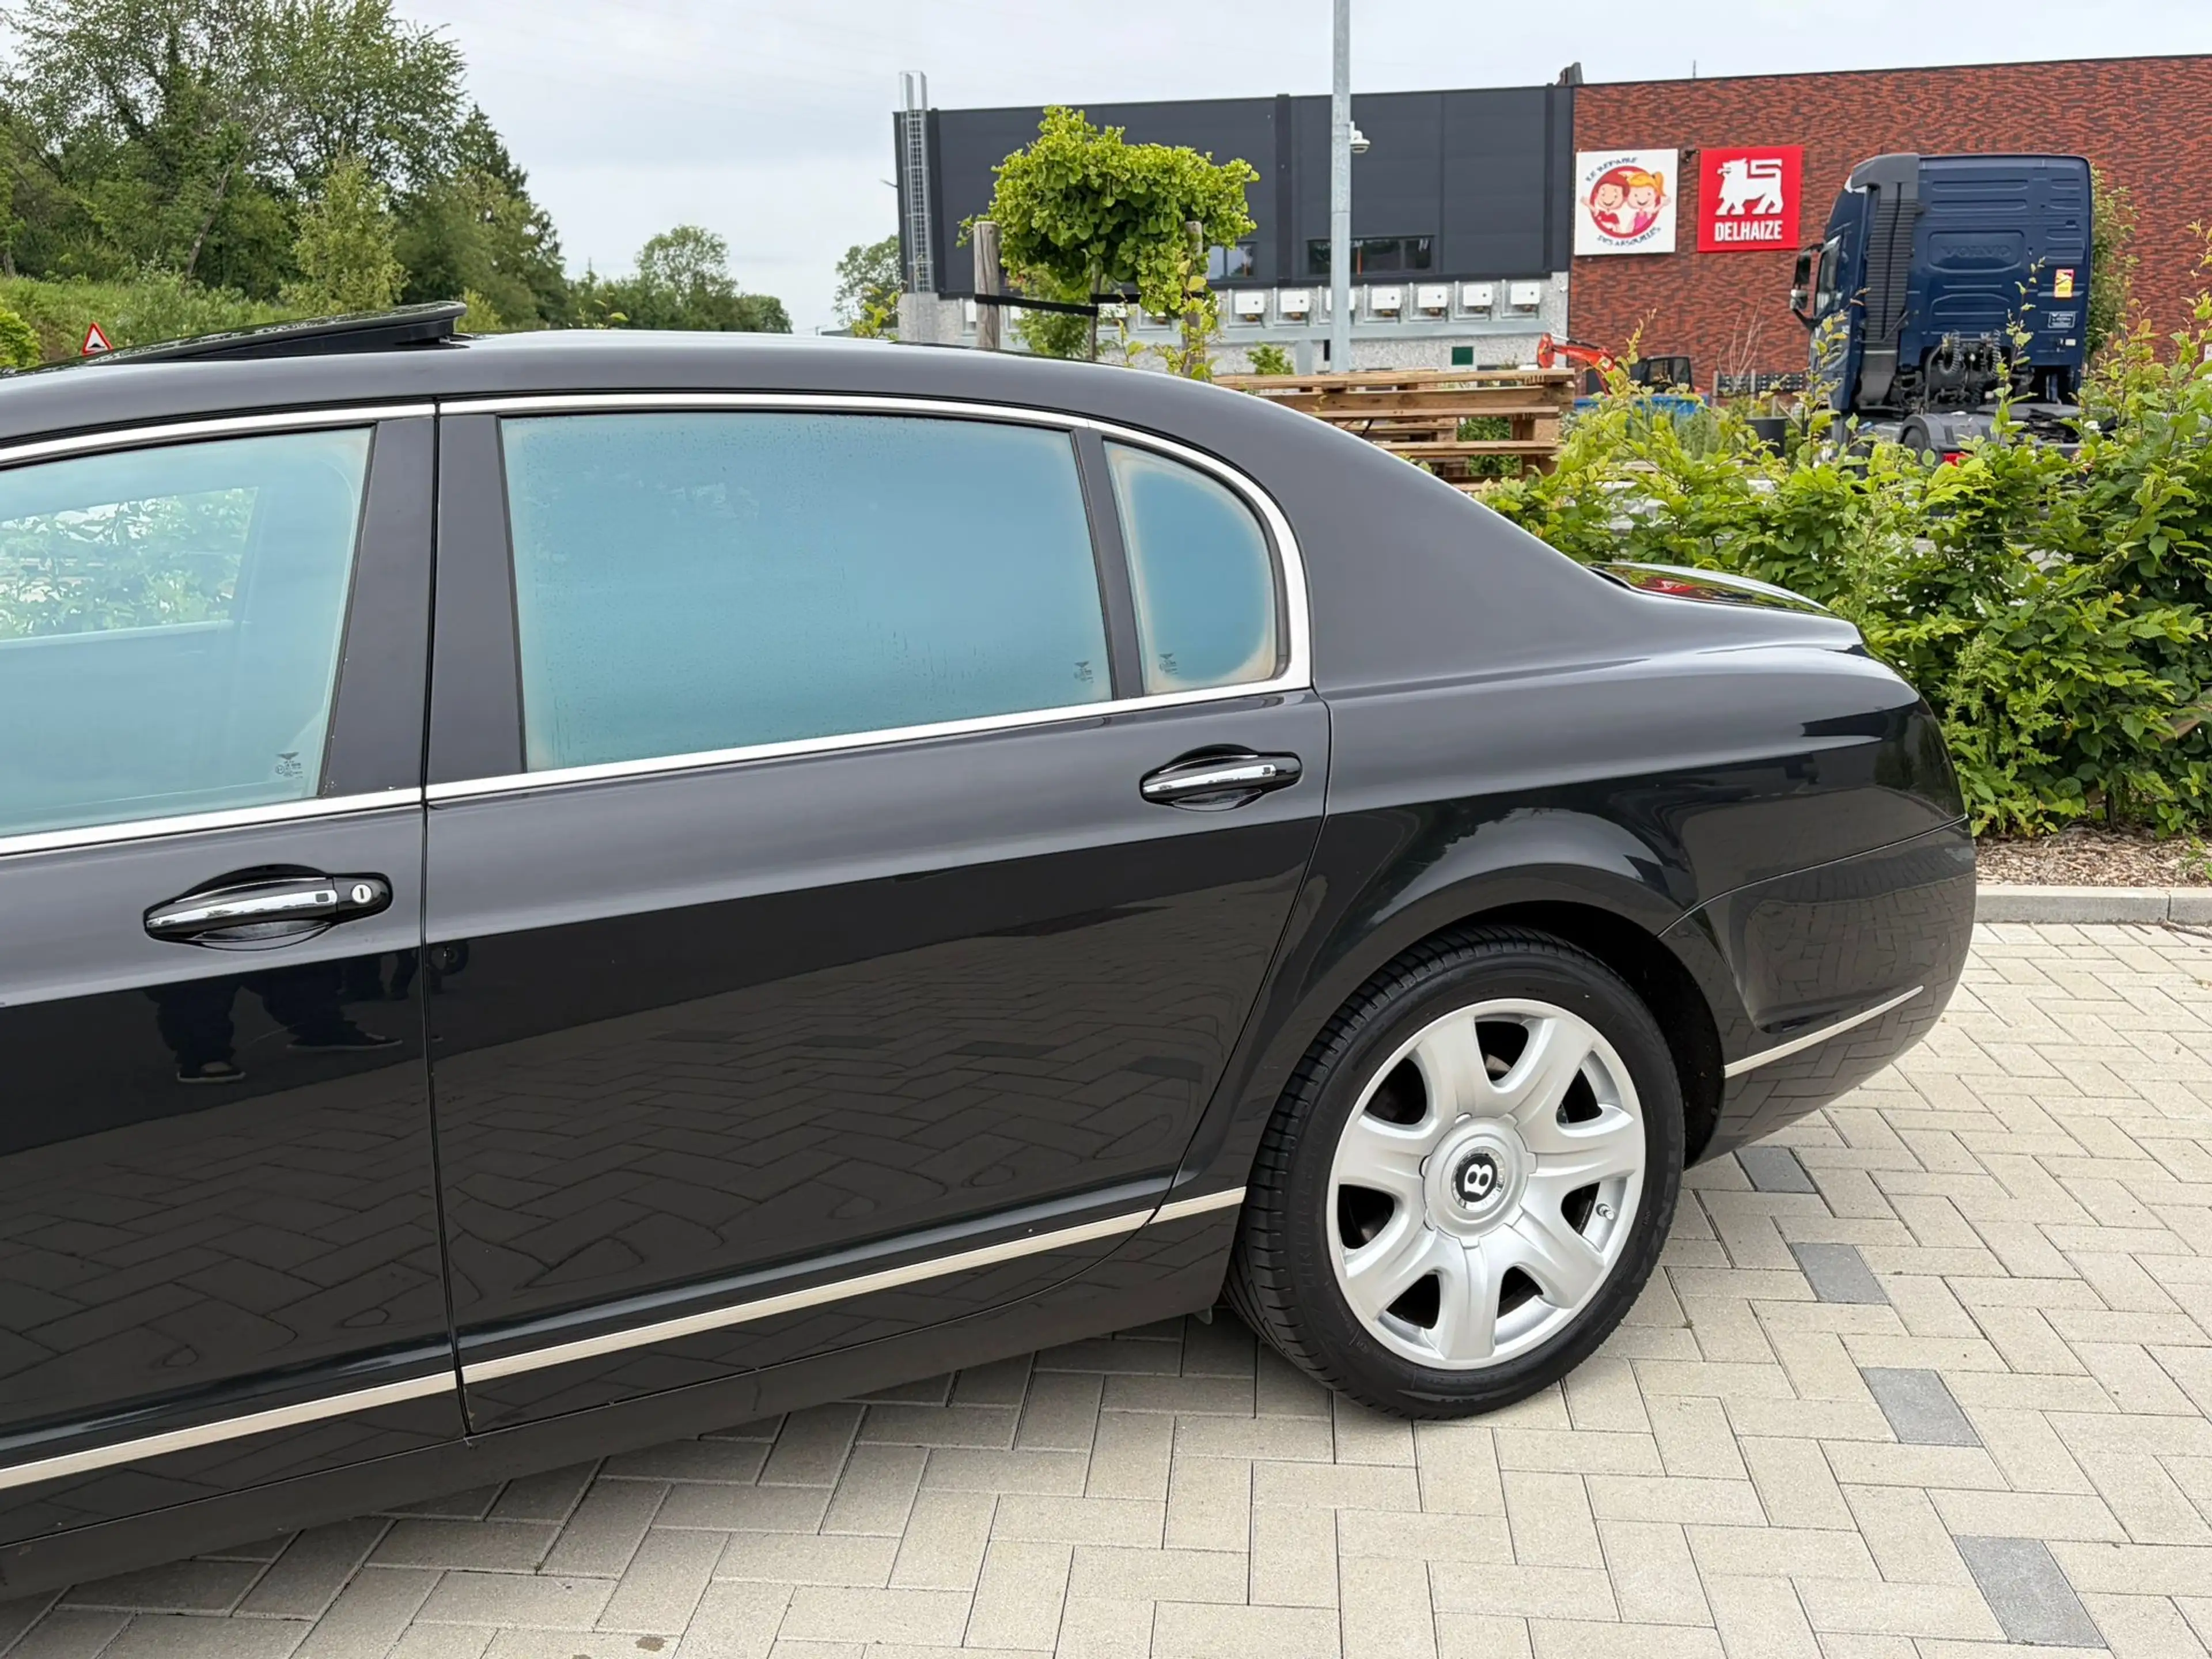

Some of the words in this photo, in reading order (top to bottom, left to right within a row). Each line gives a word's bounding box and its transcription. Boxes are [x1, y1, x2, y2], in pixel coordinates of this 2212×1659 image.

[1585, 171, 1596, 182] LE
[1715, 220, 1783, 241] DELHAIZE
[1940, 245, 2012, 257] VOLVO
[1464, 1163, 1493, 1196] B
